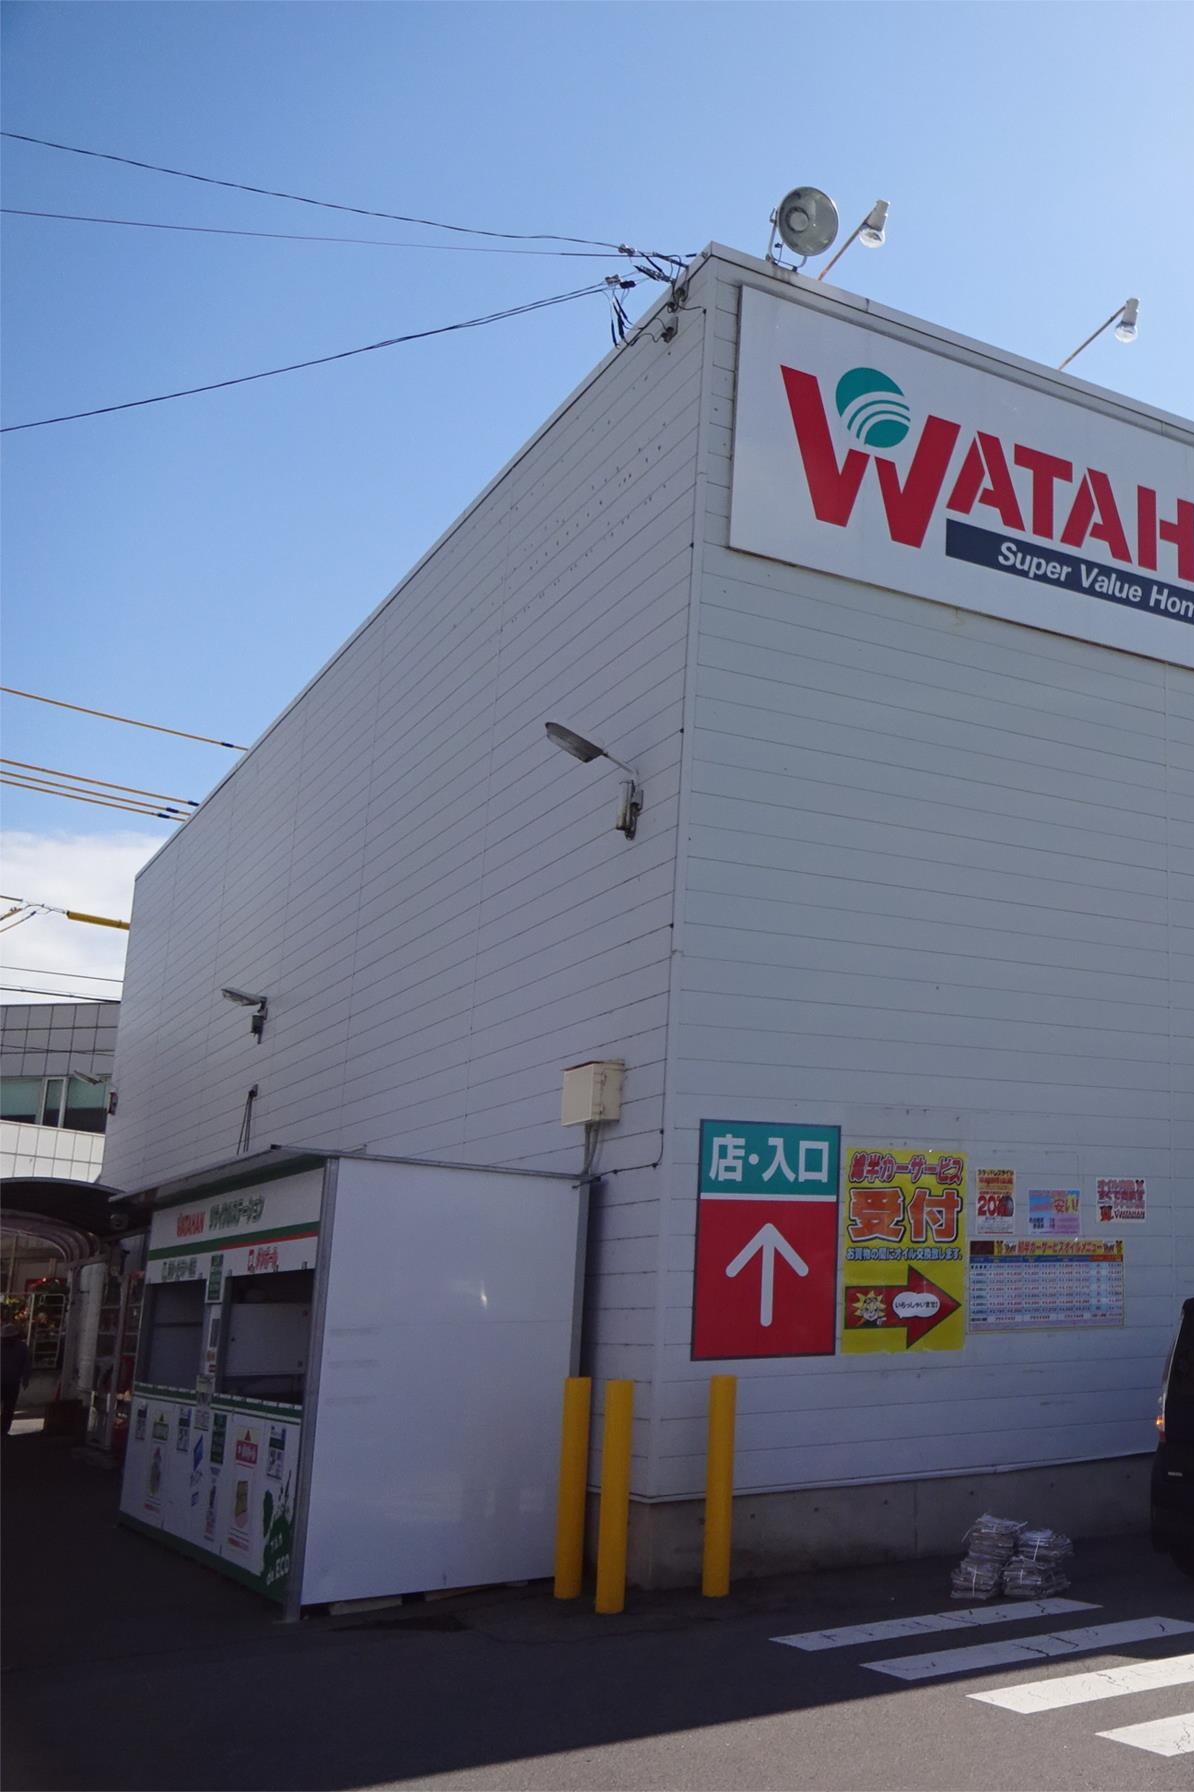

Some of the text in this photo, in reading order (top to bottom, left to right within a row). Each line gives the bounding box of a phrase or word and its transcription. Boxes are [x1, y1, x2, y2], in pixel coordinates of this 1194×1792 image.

[997, 542, 1072, 584] Super
[1079, 565, 1143, 602] Value
[709, 1133, 829, 1183] 店・入口
[848, 1187, 963, 1243] 受付
